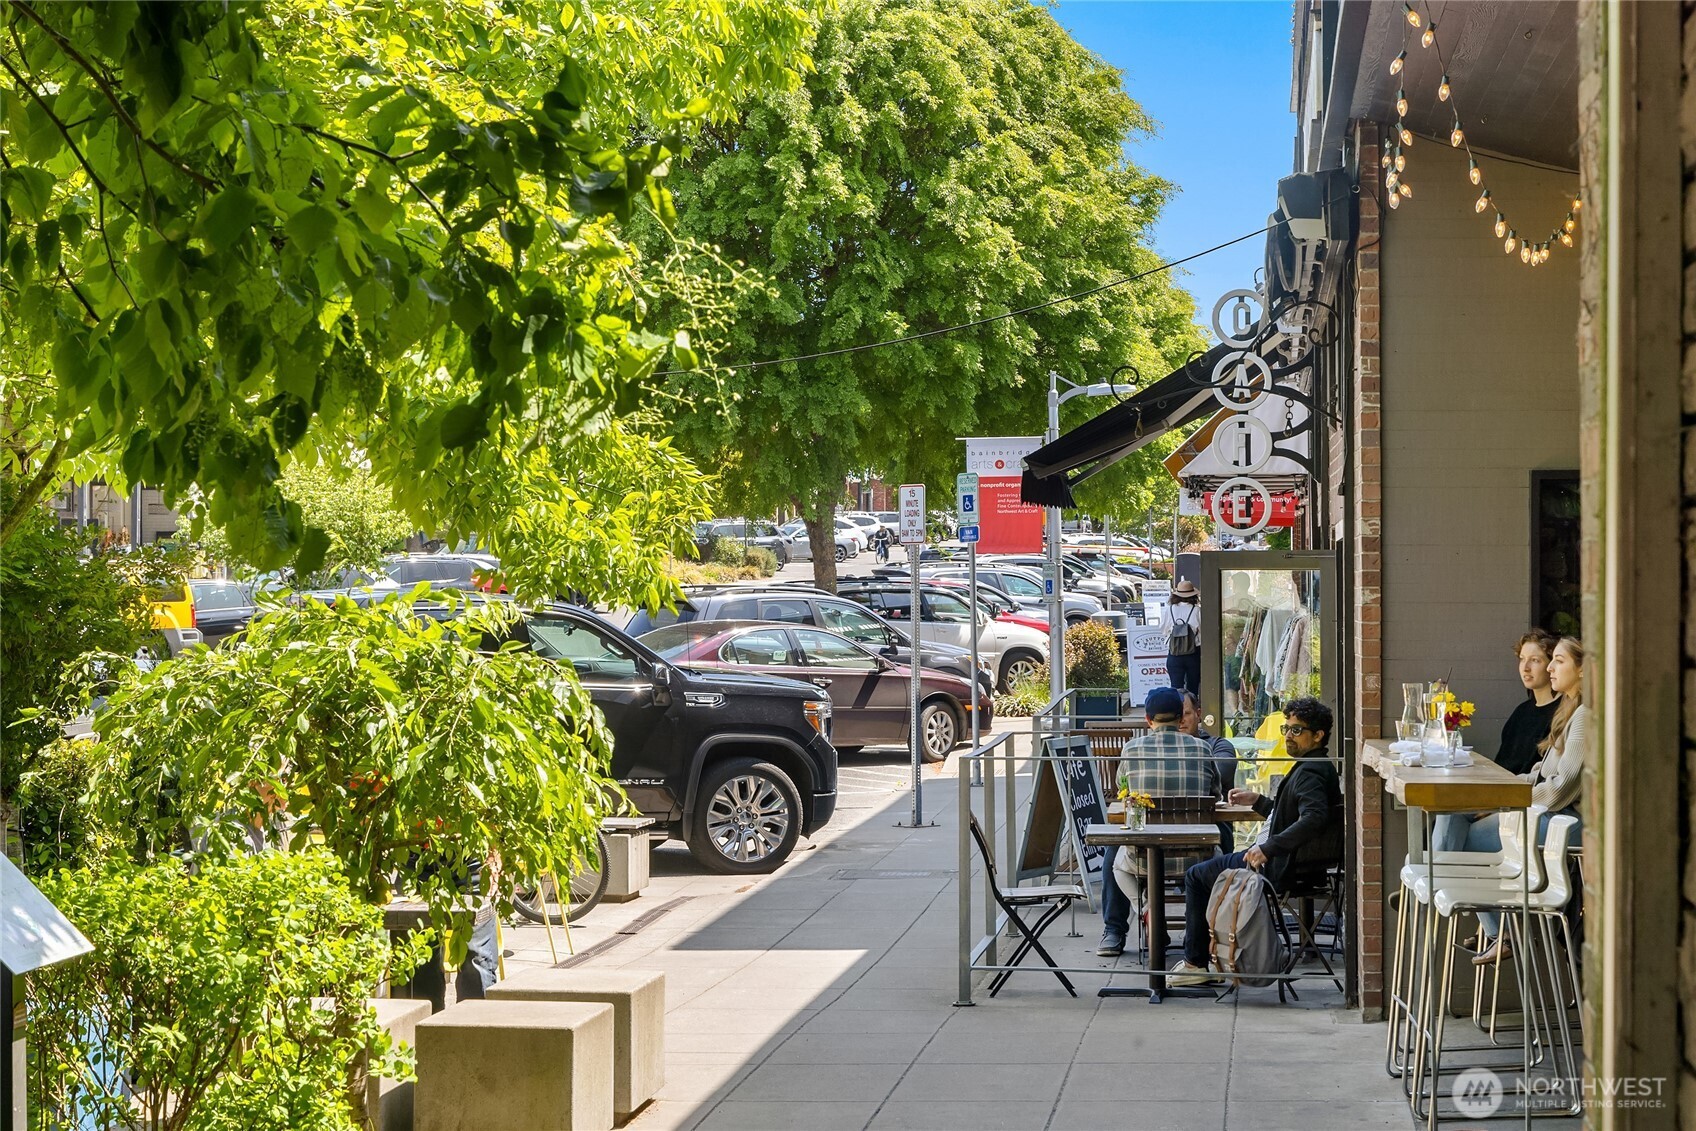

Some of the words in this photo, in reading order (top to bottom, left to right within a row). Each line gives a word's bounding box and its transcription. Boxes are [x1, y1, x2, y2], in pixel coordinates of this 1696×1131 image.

[971, 460, 994, 469] arts
[908, 489, 916, 498] 15
[905, 499, 919, 507] MINUTE
[904, 509, 920, 517] LOADING
[907, 519, 916, 527] ONLY
[910, 529, 915, 537] TO
[1141, 667, 1169, 675] OPEN
